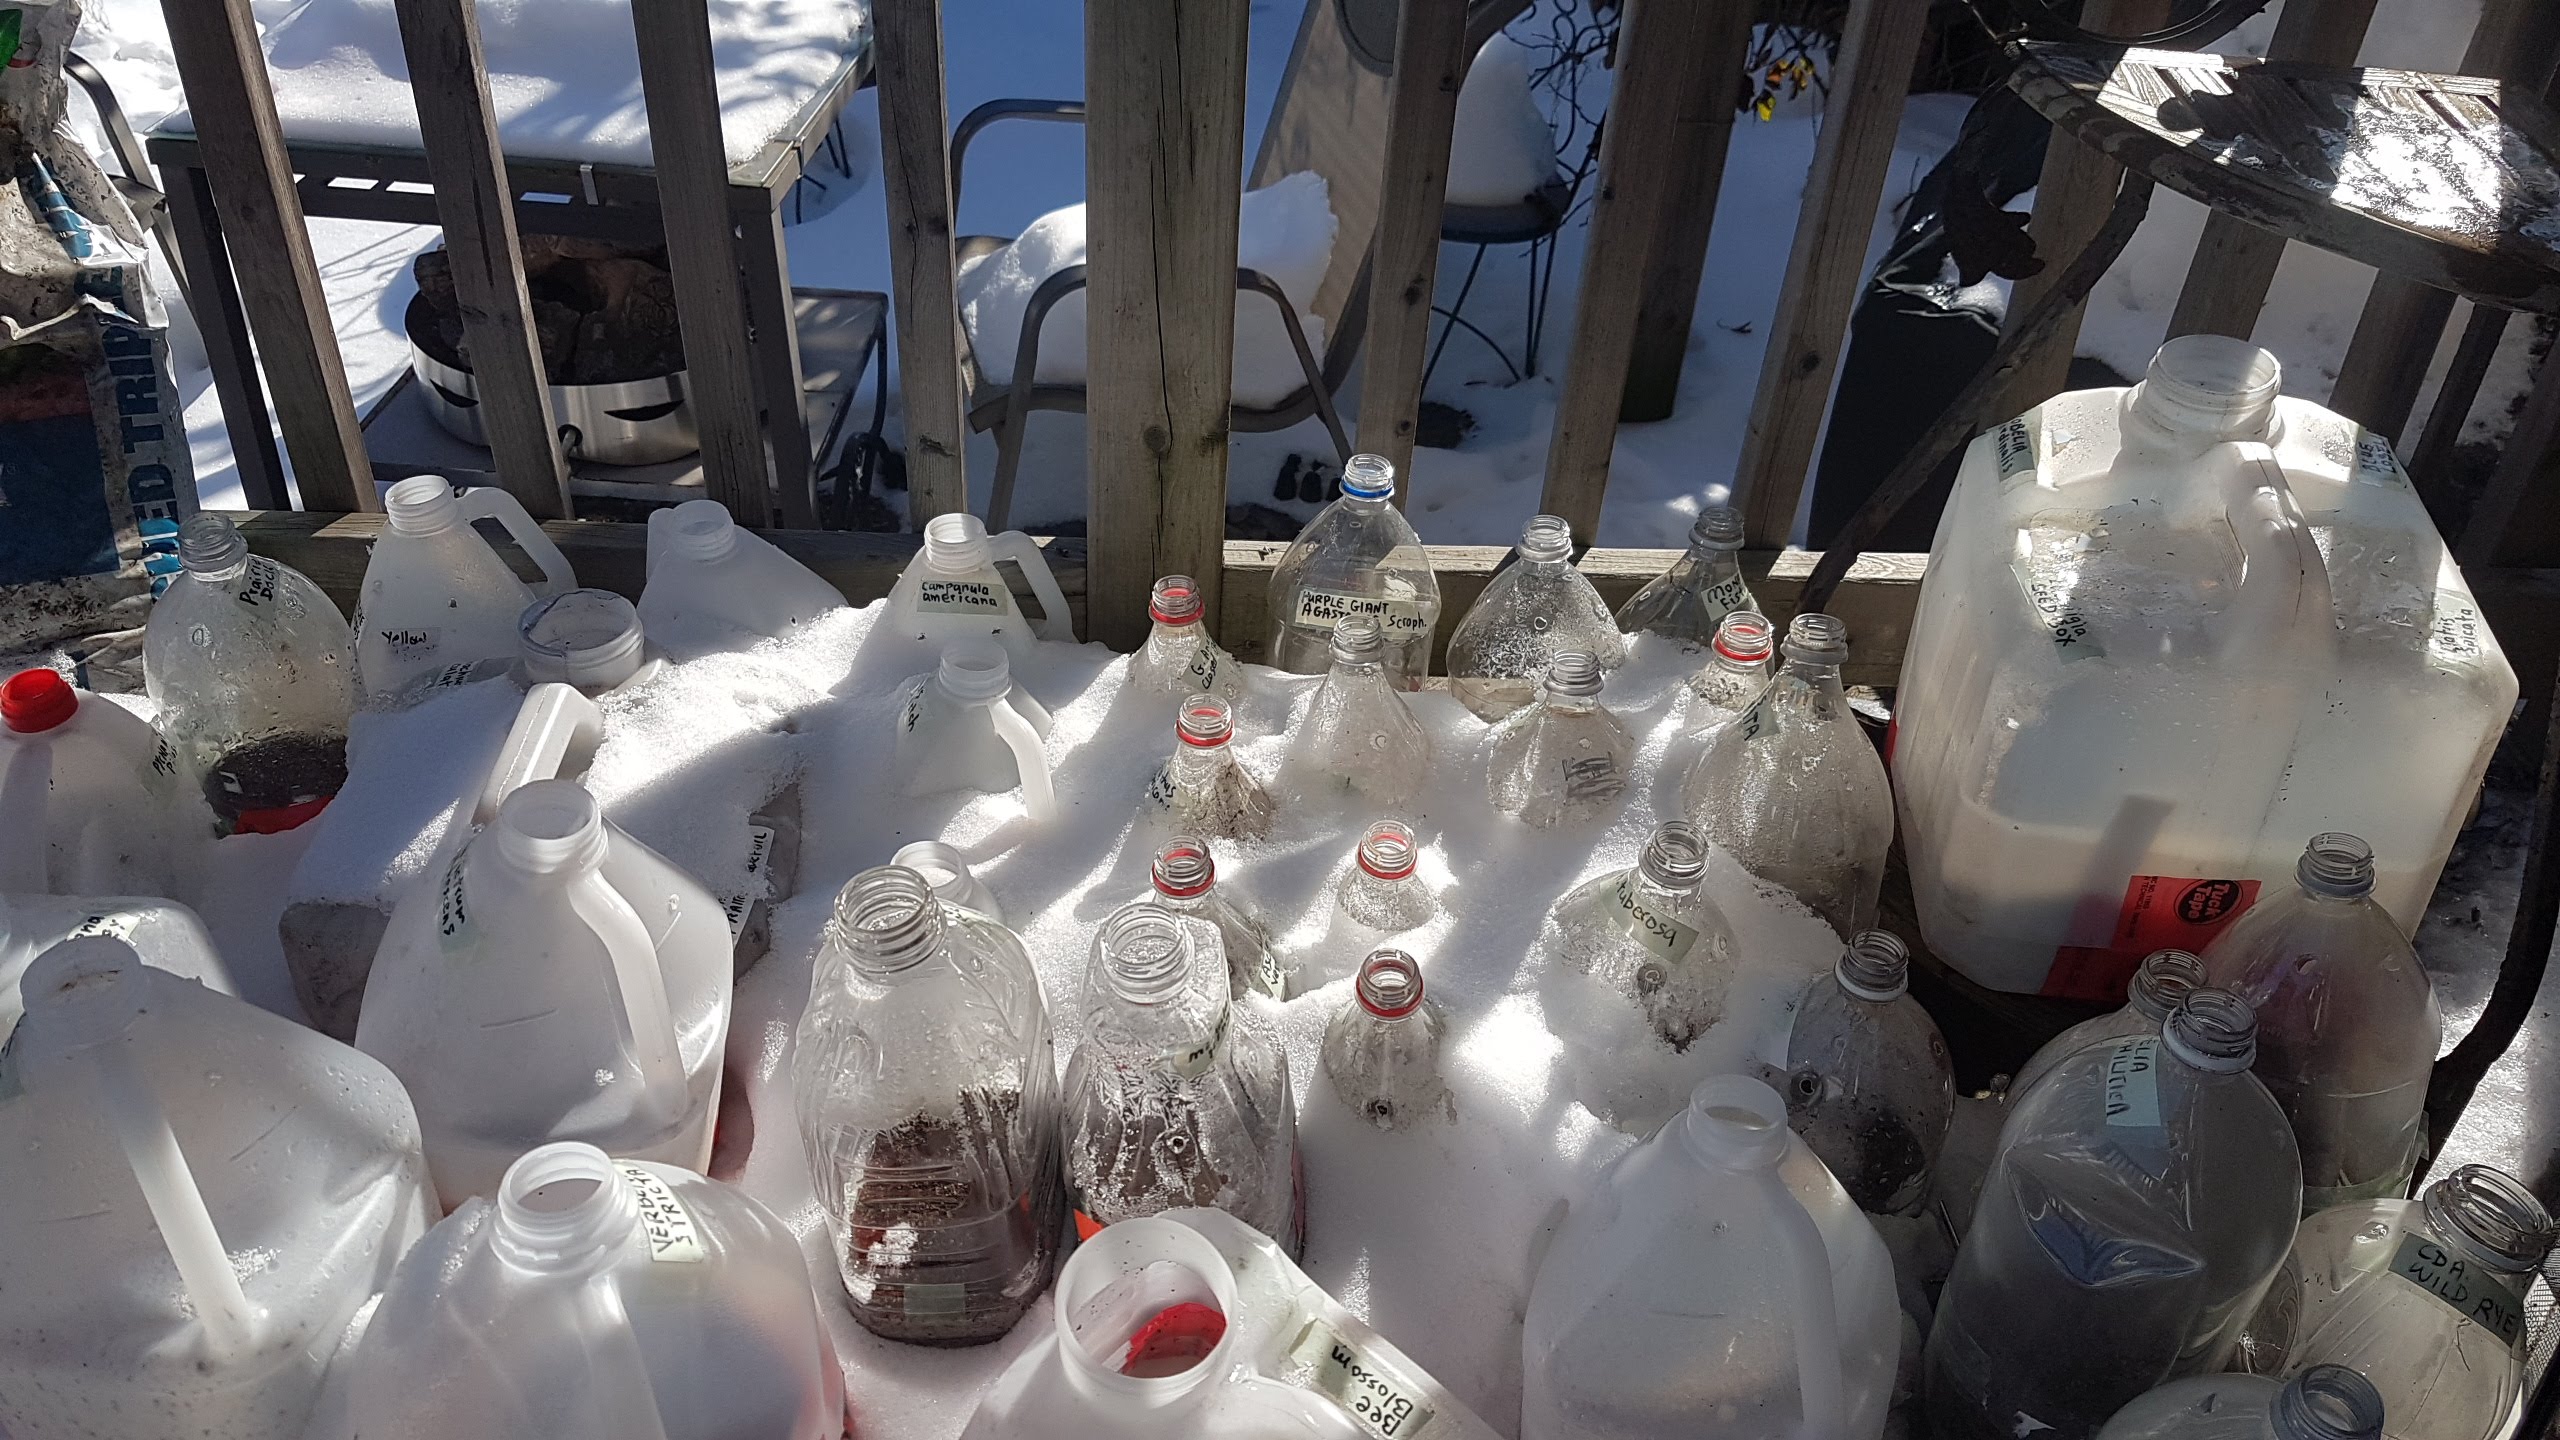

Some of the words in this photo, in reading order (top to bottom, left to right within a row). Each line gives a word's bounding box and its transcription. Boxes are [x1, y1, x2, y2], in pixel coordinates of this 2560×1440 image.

[74, 264, 164, 454] TRIPE
[1301, 592, 1345, 609] PURPLE
[1350, 599, 1390, 615] GIANT
[2188, 886, 2222, 919] Tape
[2204, 883, 2230, 917] Tuck
[2408, 1262, 2468, 1302] WILD
[2472, 1297, 2517, 1335] RYE
[1331, 1344, 1414, 1421] Blossom
[1355, 1395, 1401, 1436] Bee
